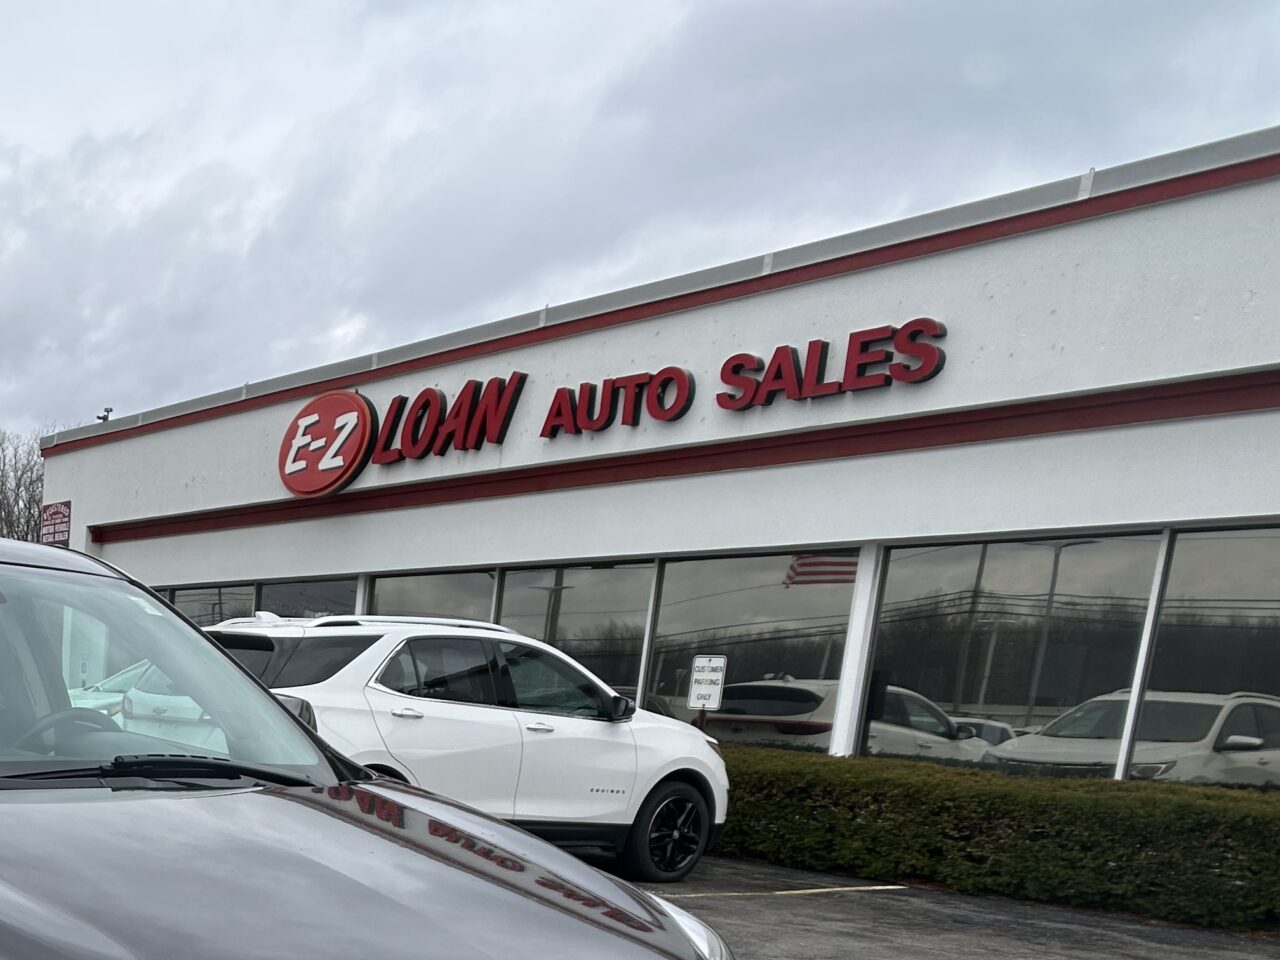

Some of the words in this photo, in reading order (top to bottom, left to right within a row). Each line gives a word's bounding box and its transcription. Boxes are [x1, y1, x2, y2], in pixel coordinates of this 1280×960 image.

[285, 409, 357, 475] E-Z
[372, 372, 527, 466] LOAN
[539, 366, 696, 439] AUTO
[716, 317, 946, 412] SALES
[694, 665, 724, 673] CUSTOMER
[694, 678, 721, 686] PARKING
[696, 693, 712, 701] ONLY
